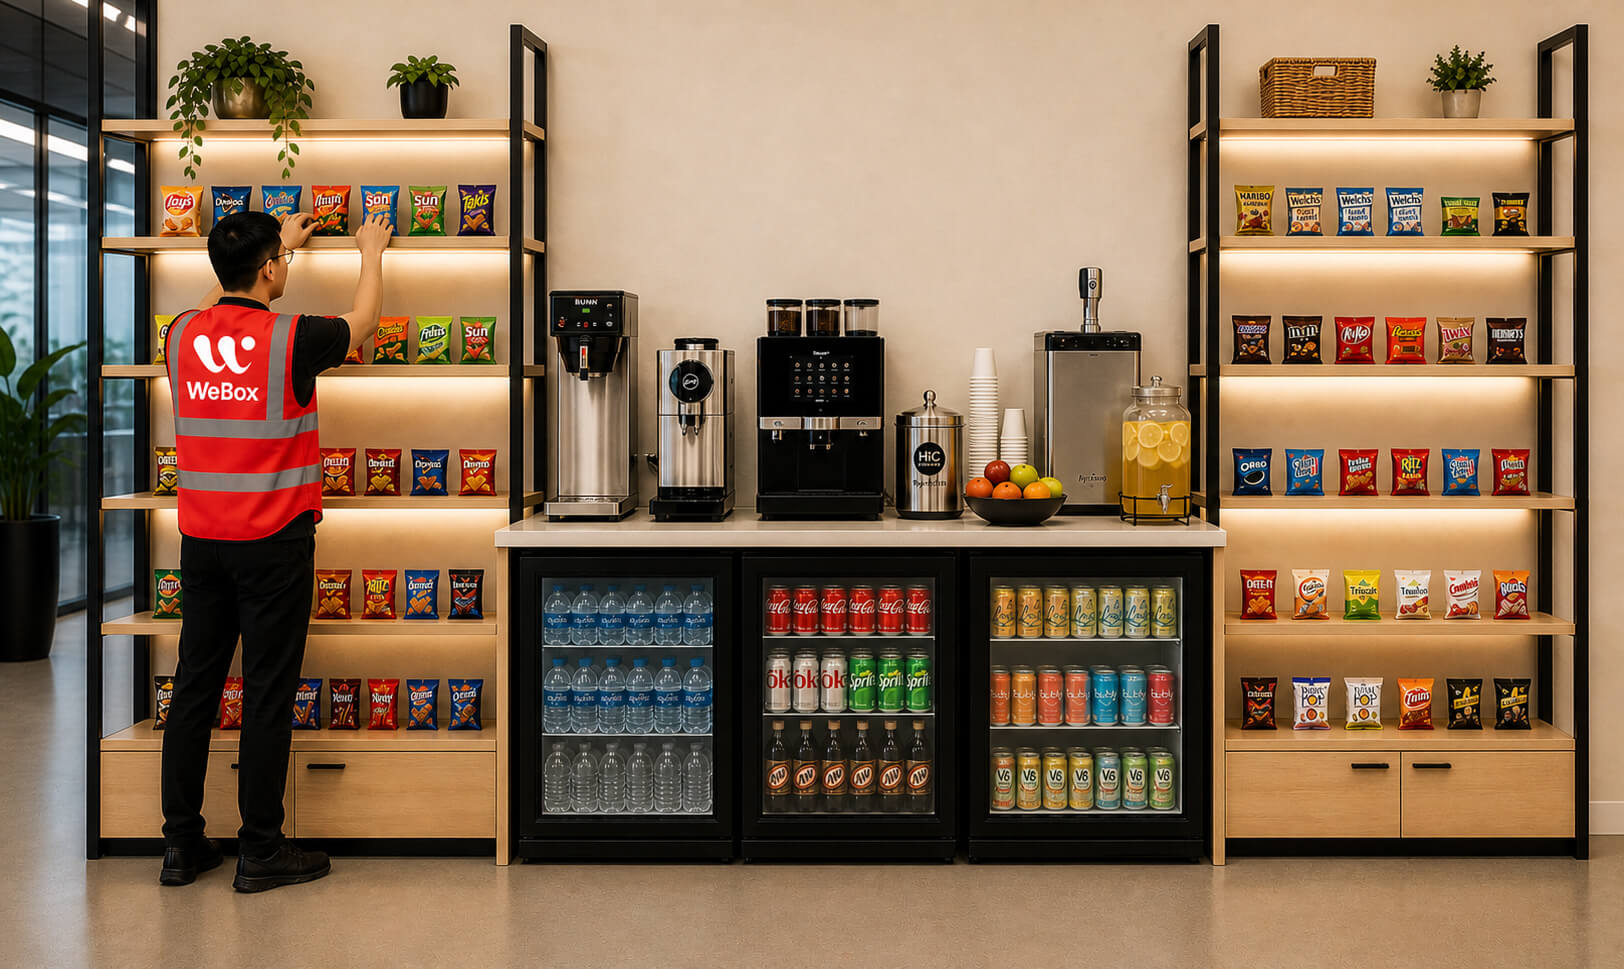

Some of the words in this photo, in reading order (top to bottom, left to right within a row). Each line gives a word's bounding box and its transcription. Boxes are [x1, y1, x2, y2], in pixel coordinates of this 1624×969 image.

[414, 195, 438, 206] Sun
[465, 327, 488, 337] Sun
[186, 381, 260, 401] WeBox
[918, 451, 941, 462] HiC
